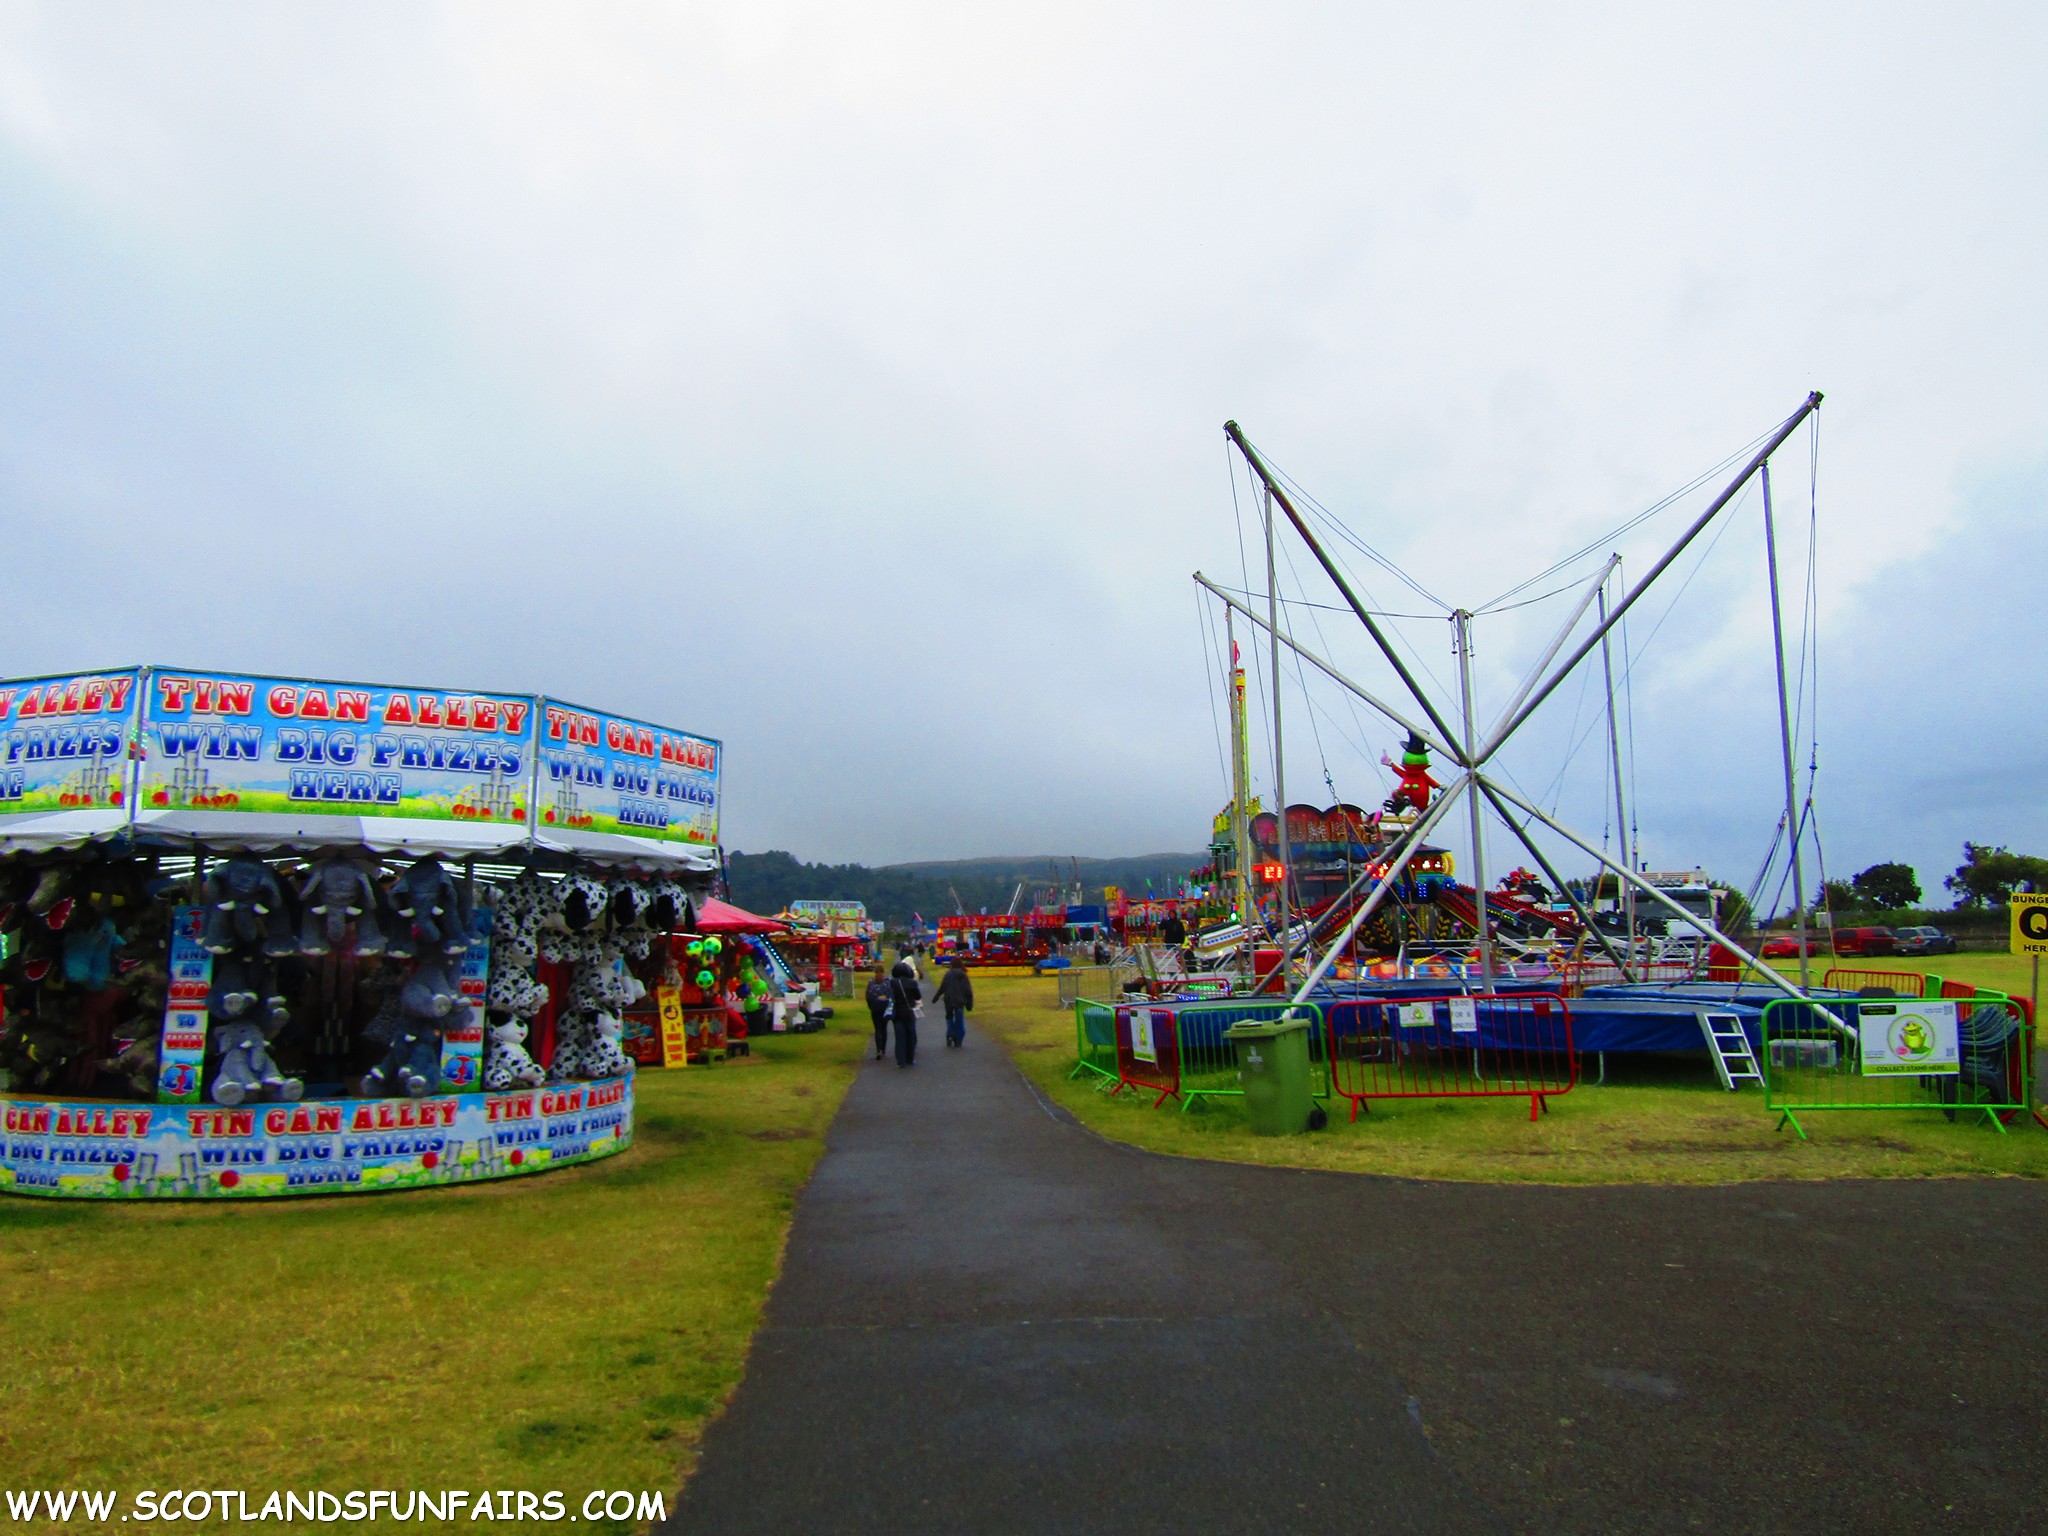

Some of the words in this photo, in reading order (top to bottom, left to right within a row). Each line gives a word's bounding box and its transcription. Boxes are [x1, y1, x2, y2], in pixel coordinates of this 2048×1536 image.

[17, 676, 133, 719] ALLEY
[158, 676, 254, 716] TIN
[267, 685, 371, 722] CAN
[384, 694, 528, 735] ALLEY
[6, 721, 124, 763] PRIZES
[158, 722, 262, 760] WIN
[276, 727, 358, 766] BIG
[370, 733, 522, 776] PRIZES
[546, 706, 599, 748] TIN
[606, 720, 655, 758] CAN
[660, 733, 717, 773] ALLEY
[288, 767, 401, 805] HERE
[547, 748, 605, 788] WIN
[612, 759, 649, 795] BIG
[655, 768, 715, 807] PRIZES
[618, 795, 669, 830] HERE
[2018, 906, 2048, 940] Q
[176, 1013, 198, 1028] TO
[164, 1066, 197, 1092] £1
[446, 1058, 477, 1081] £1
[1876, 1065, 1904, 1073] COLLECT
[485, 1093, 535, 1123] TIN
[540, 1088, 583, 1118] CAN
[586, 1079, 626, 1110] ALLEY
[6, 1106, 51, 1135] CAN
[55, 1108, 153, 1138] ALLEY
[187, 1108, 255, 1138] TIN
[265, 1106, 342, 1136] CAN
[351, 1100, 460, 1133] ALLEY
[494, 1119, 544, 1147] WIN
[547, 1116, 579, 1140] BIG
[10, 1138, 46, 1161] BIG
[49, 1140, 138, 1165] PRIZES
[198, 1138, 268, 1166] WIN
[276, 1136, 333, 1163] BIG
[341, 1130, 446, 1159] PRIZES
[15, 1164, 59, 1188] HERE
[286, 1162, 363, 1187] HERE
